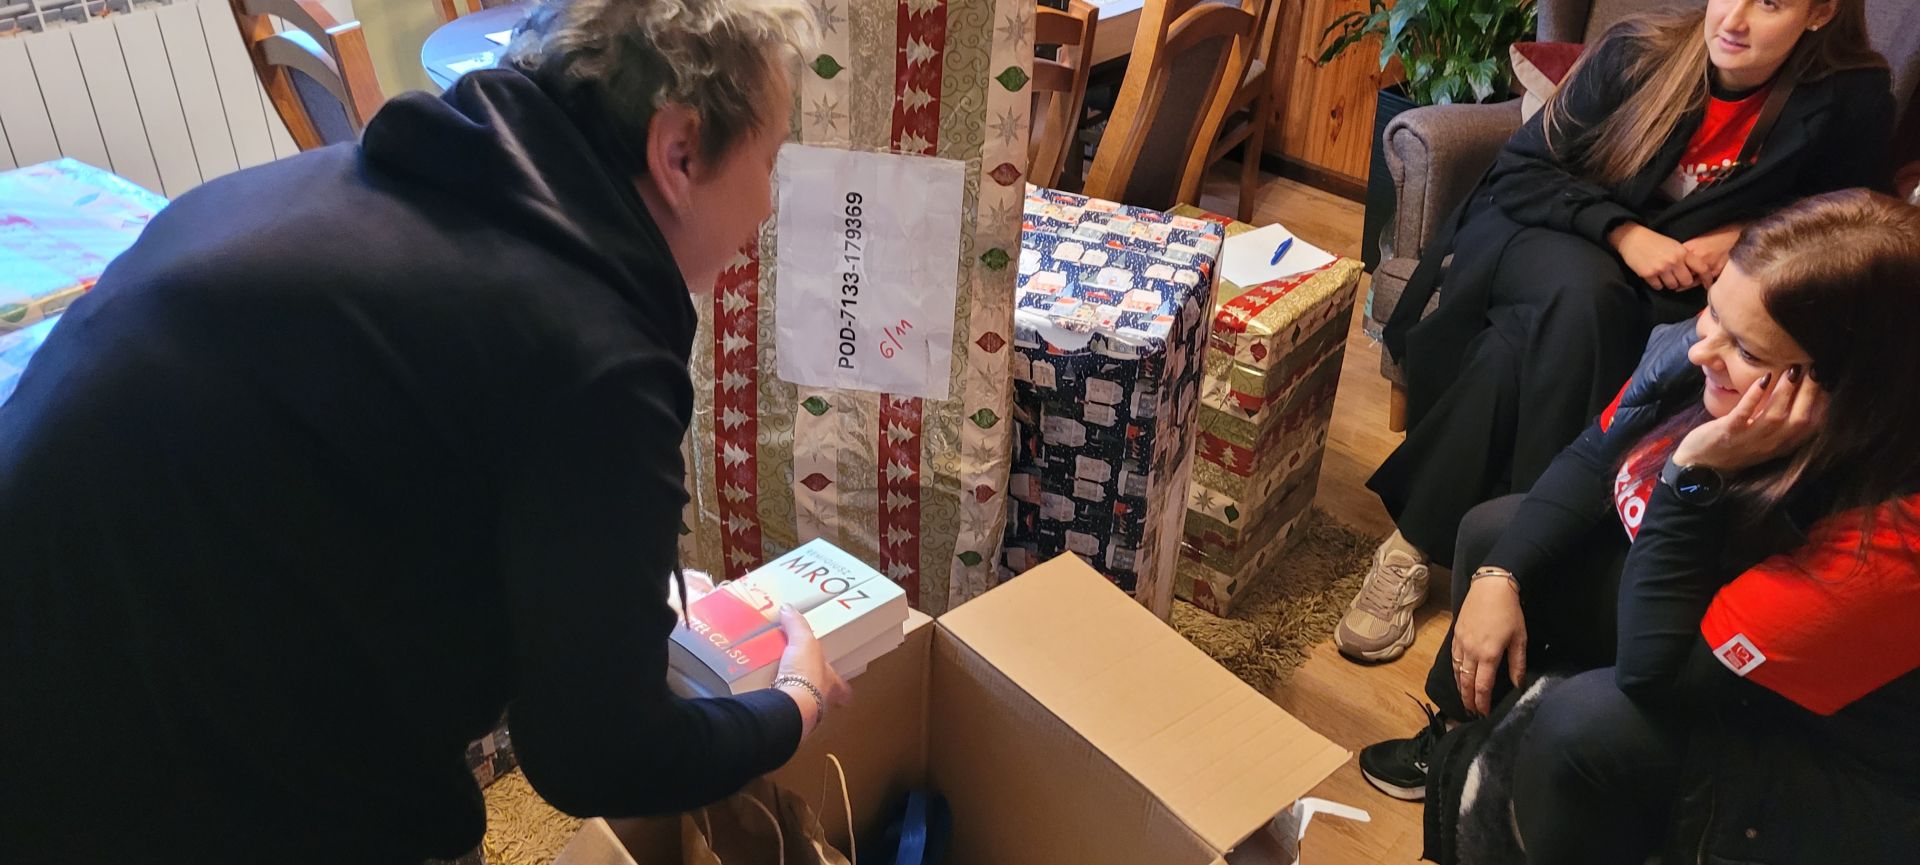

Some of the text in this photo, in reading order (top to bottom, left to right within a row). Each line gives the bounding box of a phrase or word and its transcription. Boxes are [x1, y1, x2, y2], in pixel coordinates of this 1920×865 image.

[838, 191, 863, 369] POD-7133-179369
[879, 319, 913, 359] 6/11
[780, 555, 870, 610] MRÓZ
